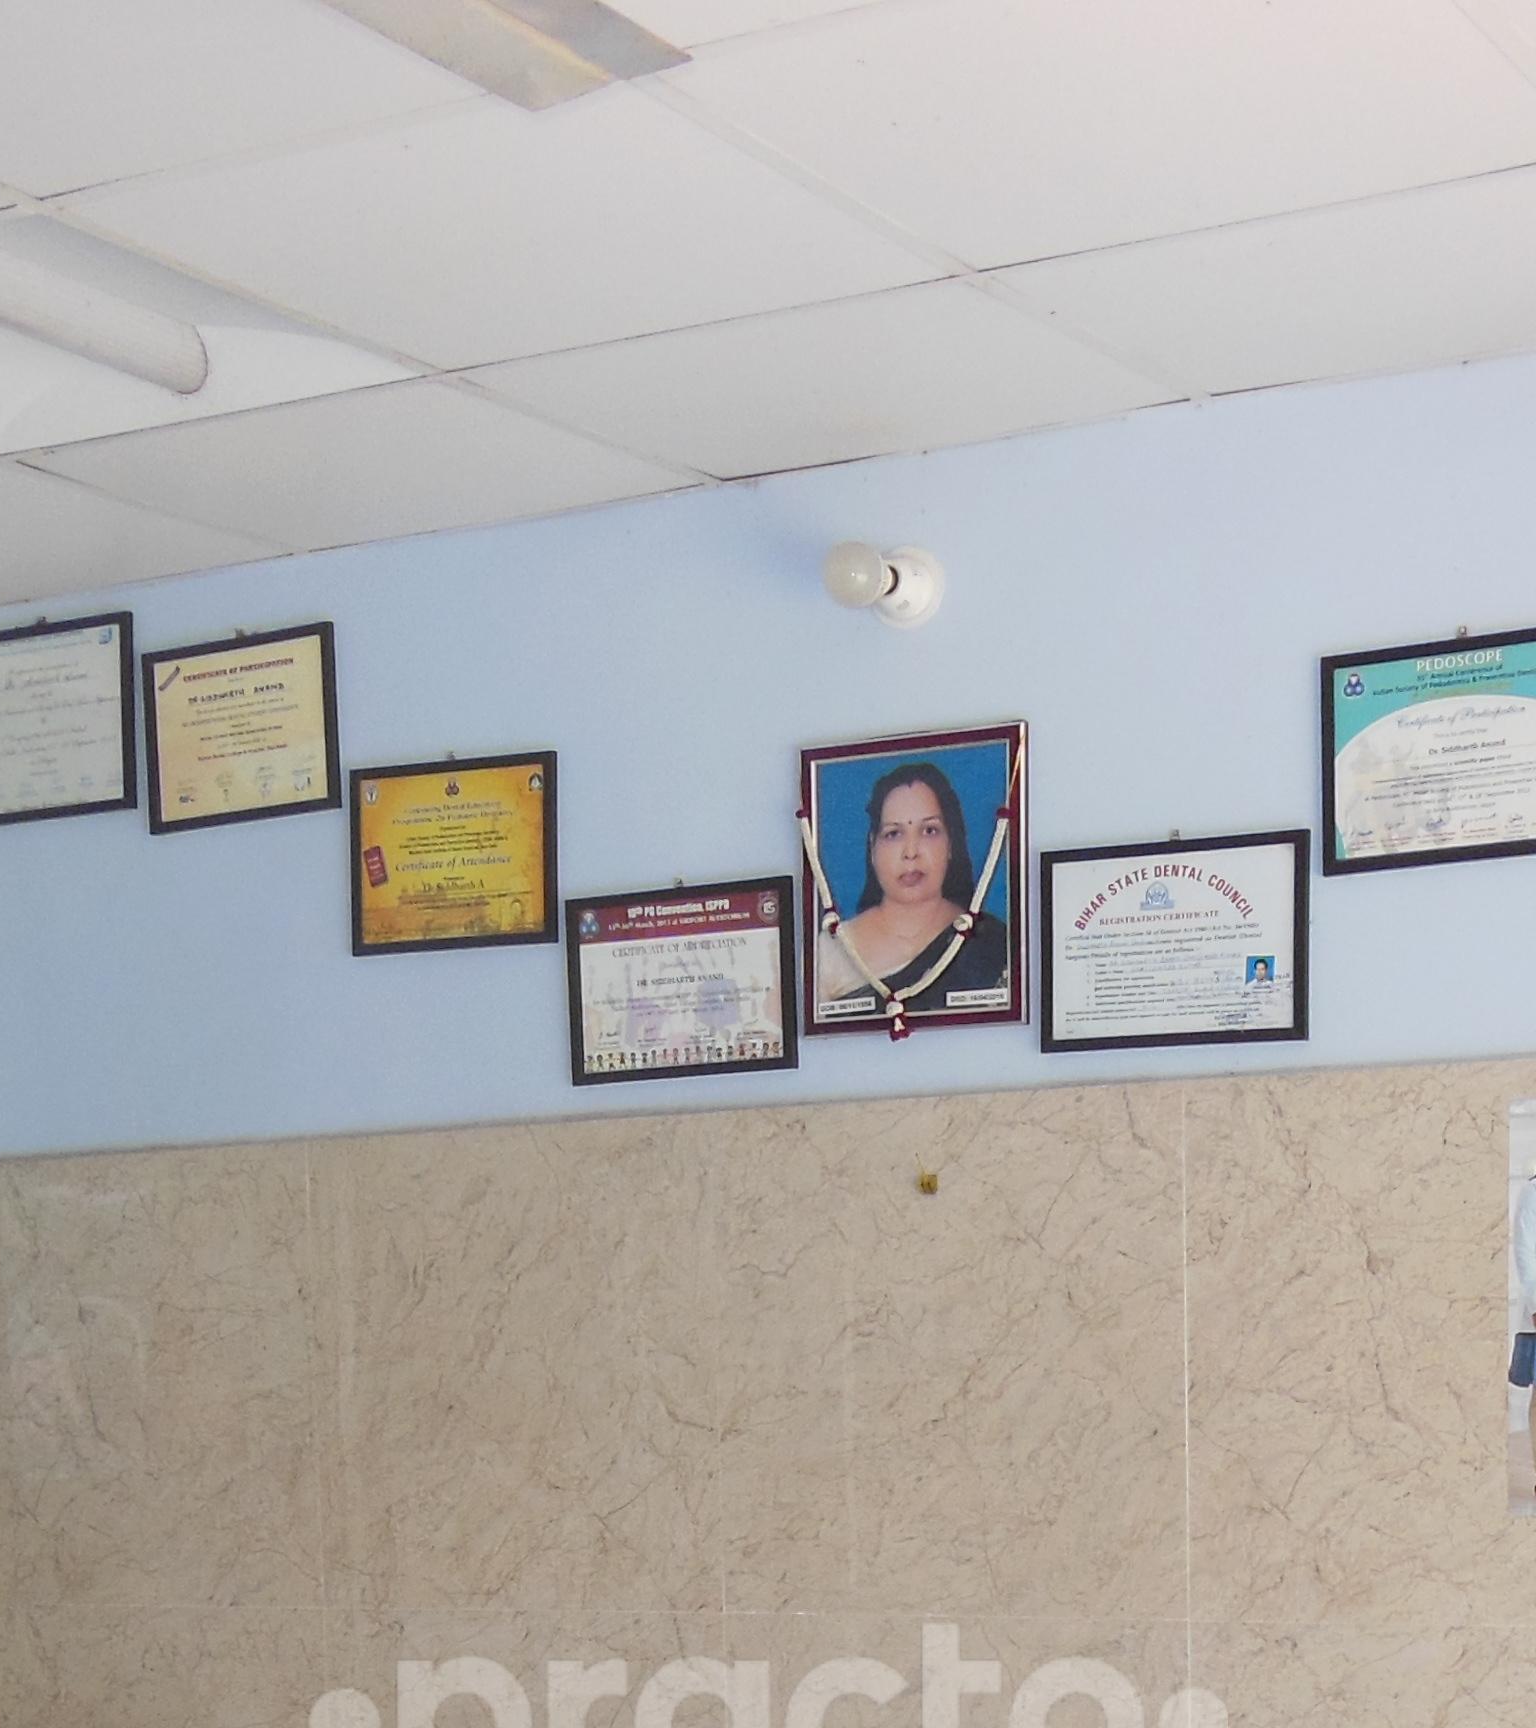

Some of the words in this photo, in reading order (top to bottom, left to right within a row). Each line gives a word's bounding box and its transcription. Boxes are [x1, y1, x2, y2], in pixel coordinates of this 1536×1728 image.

[1417, 649, 1503, 672] PEDOSCOPE
[1074, 893, 1108, 930] BIHAR
[1108, 867, 1149, 896] STATE
[1154, 864, 1203, 882] DENTAL
[1207, 874, 1254, 919] COUNCIL
[1099, 914, 1162, 926] REGISTRATION
